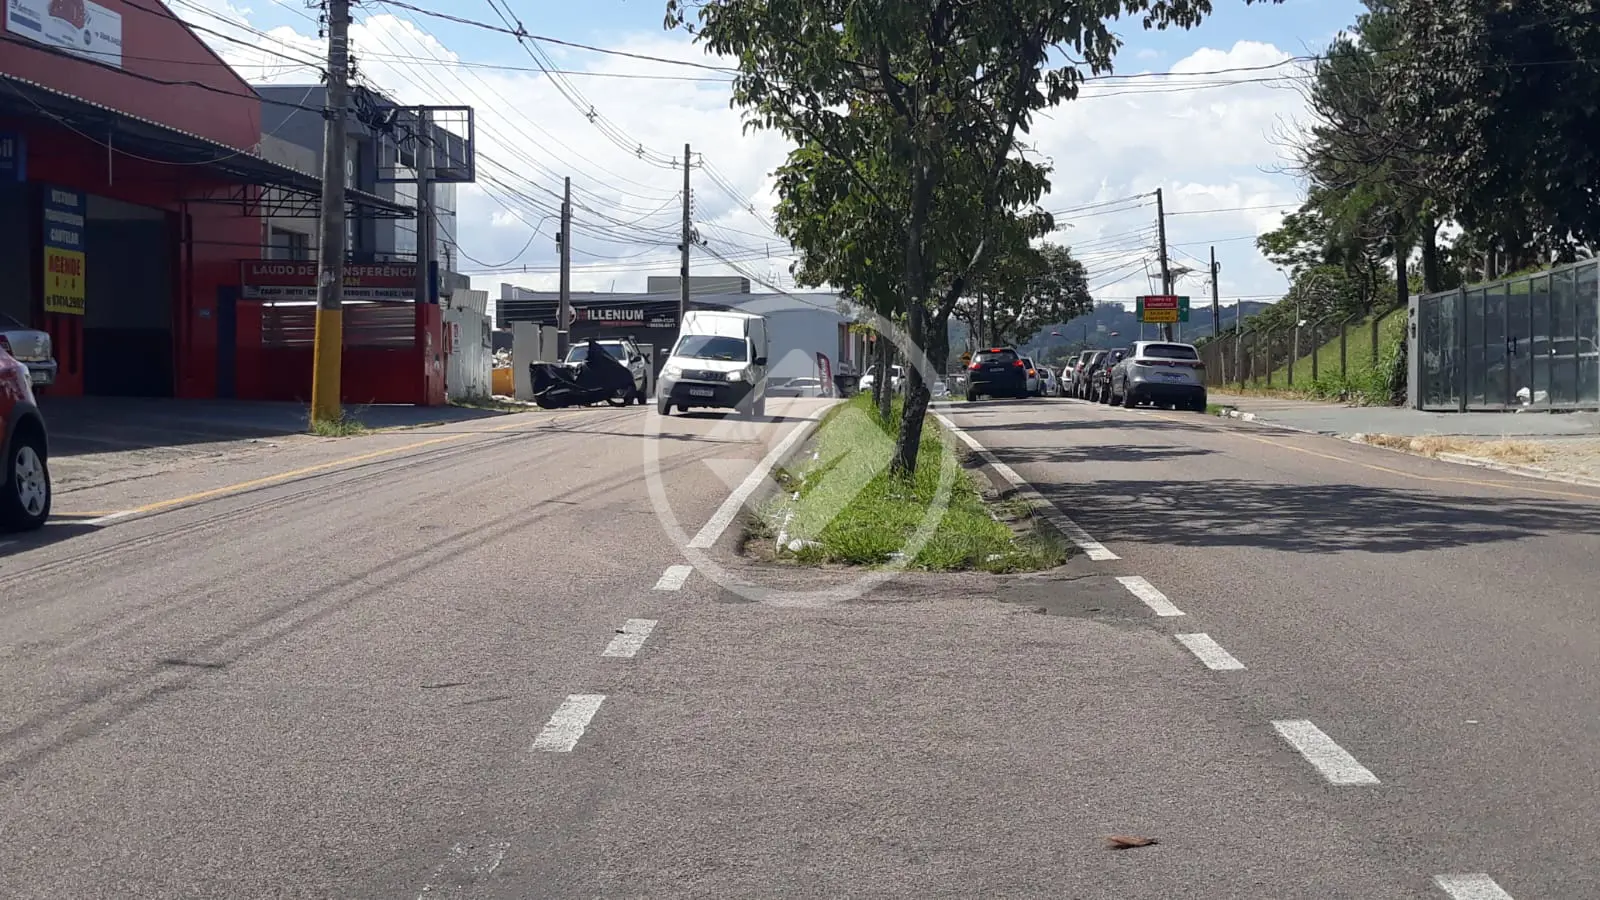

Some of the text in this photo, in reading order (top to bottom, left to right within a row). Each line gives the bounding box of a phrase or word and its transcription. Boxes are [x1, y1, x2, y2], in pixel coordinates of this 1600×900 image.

[48, 255, 81, 276] AGENDE
[252, 265, 295, 275] LAUDO
[297, 265, 316, 276] DE
[577, 309, 644, 320] MILLENIUM
